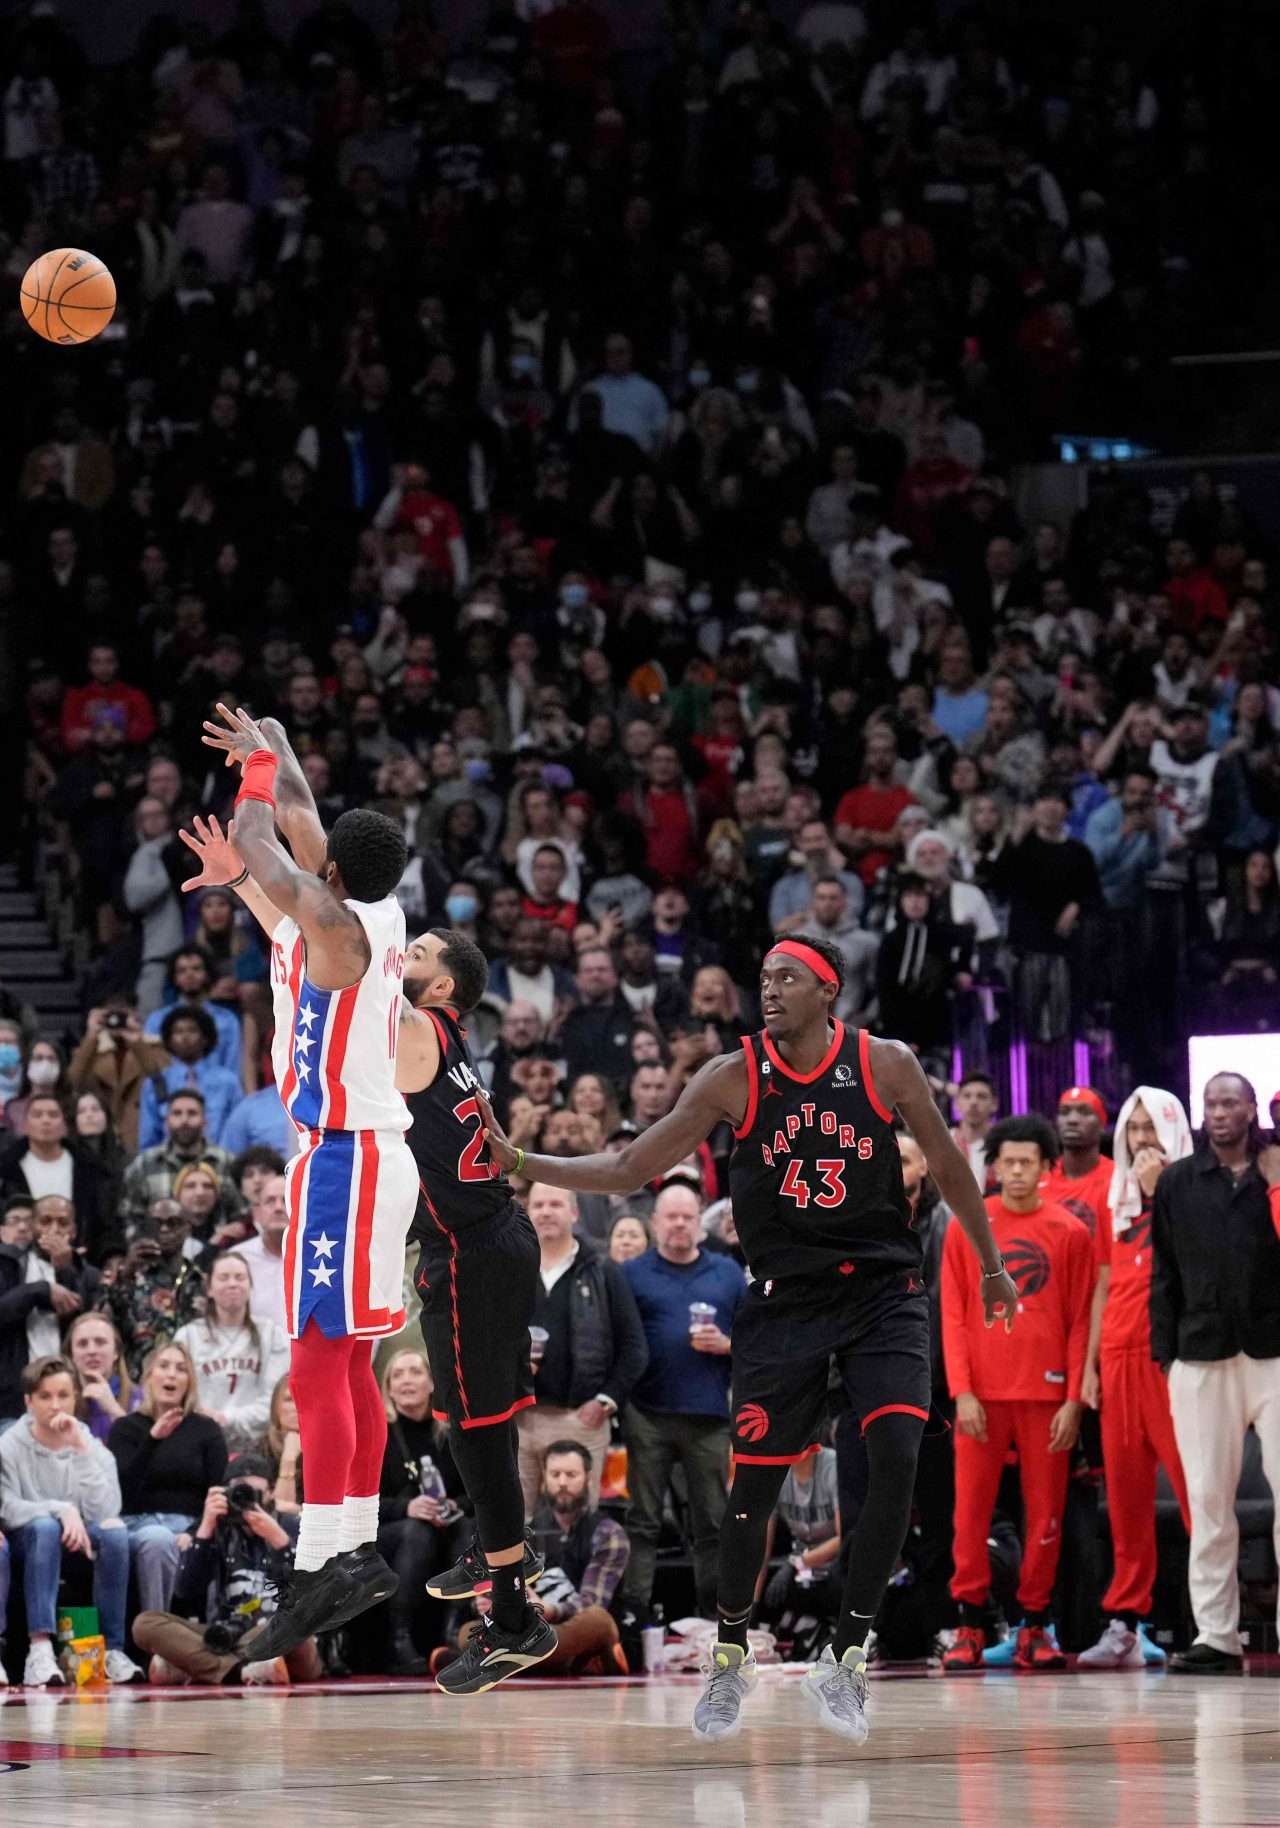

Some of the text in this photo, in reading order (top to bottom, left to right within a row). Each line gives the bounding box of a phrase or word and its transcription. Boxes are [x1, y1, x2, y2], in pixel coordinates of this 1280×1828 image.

[762, 1061, 770, 1074] 6
[452, 1096, 501, 1183] 2
[761, 1103, 873, 1167] RAPTORS
[779, 1159, 847, 1209] 43
[227, 1373, 237, 1395] 7
